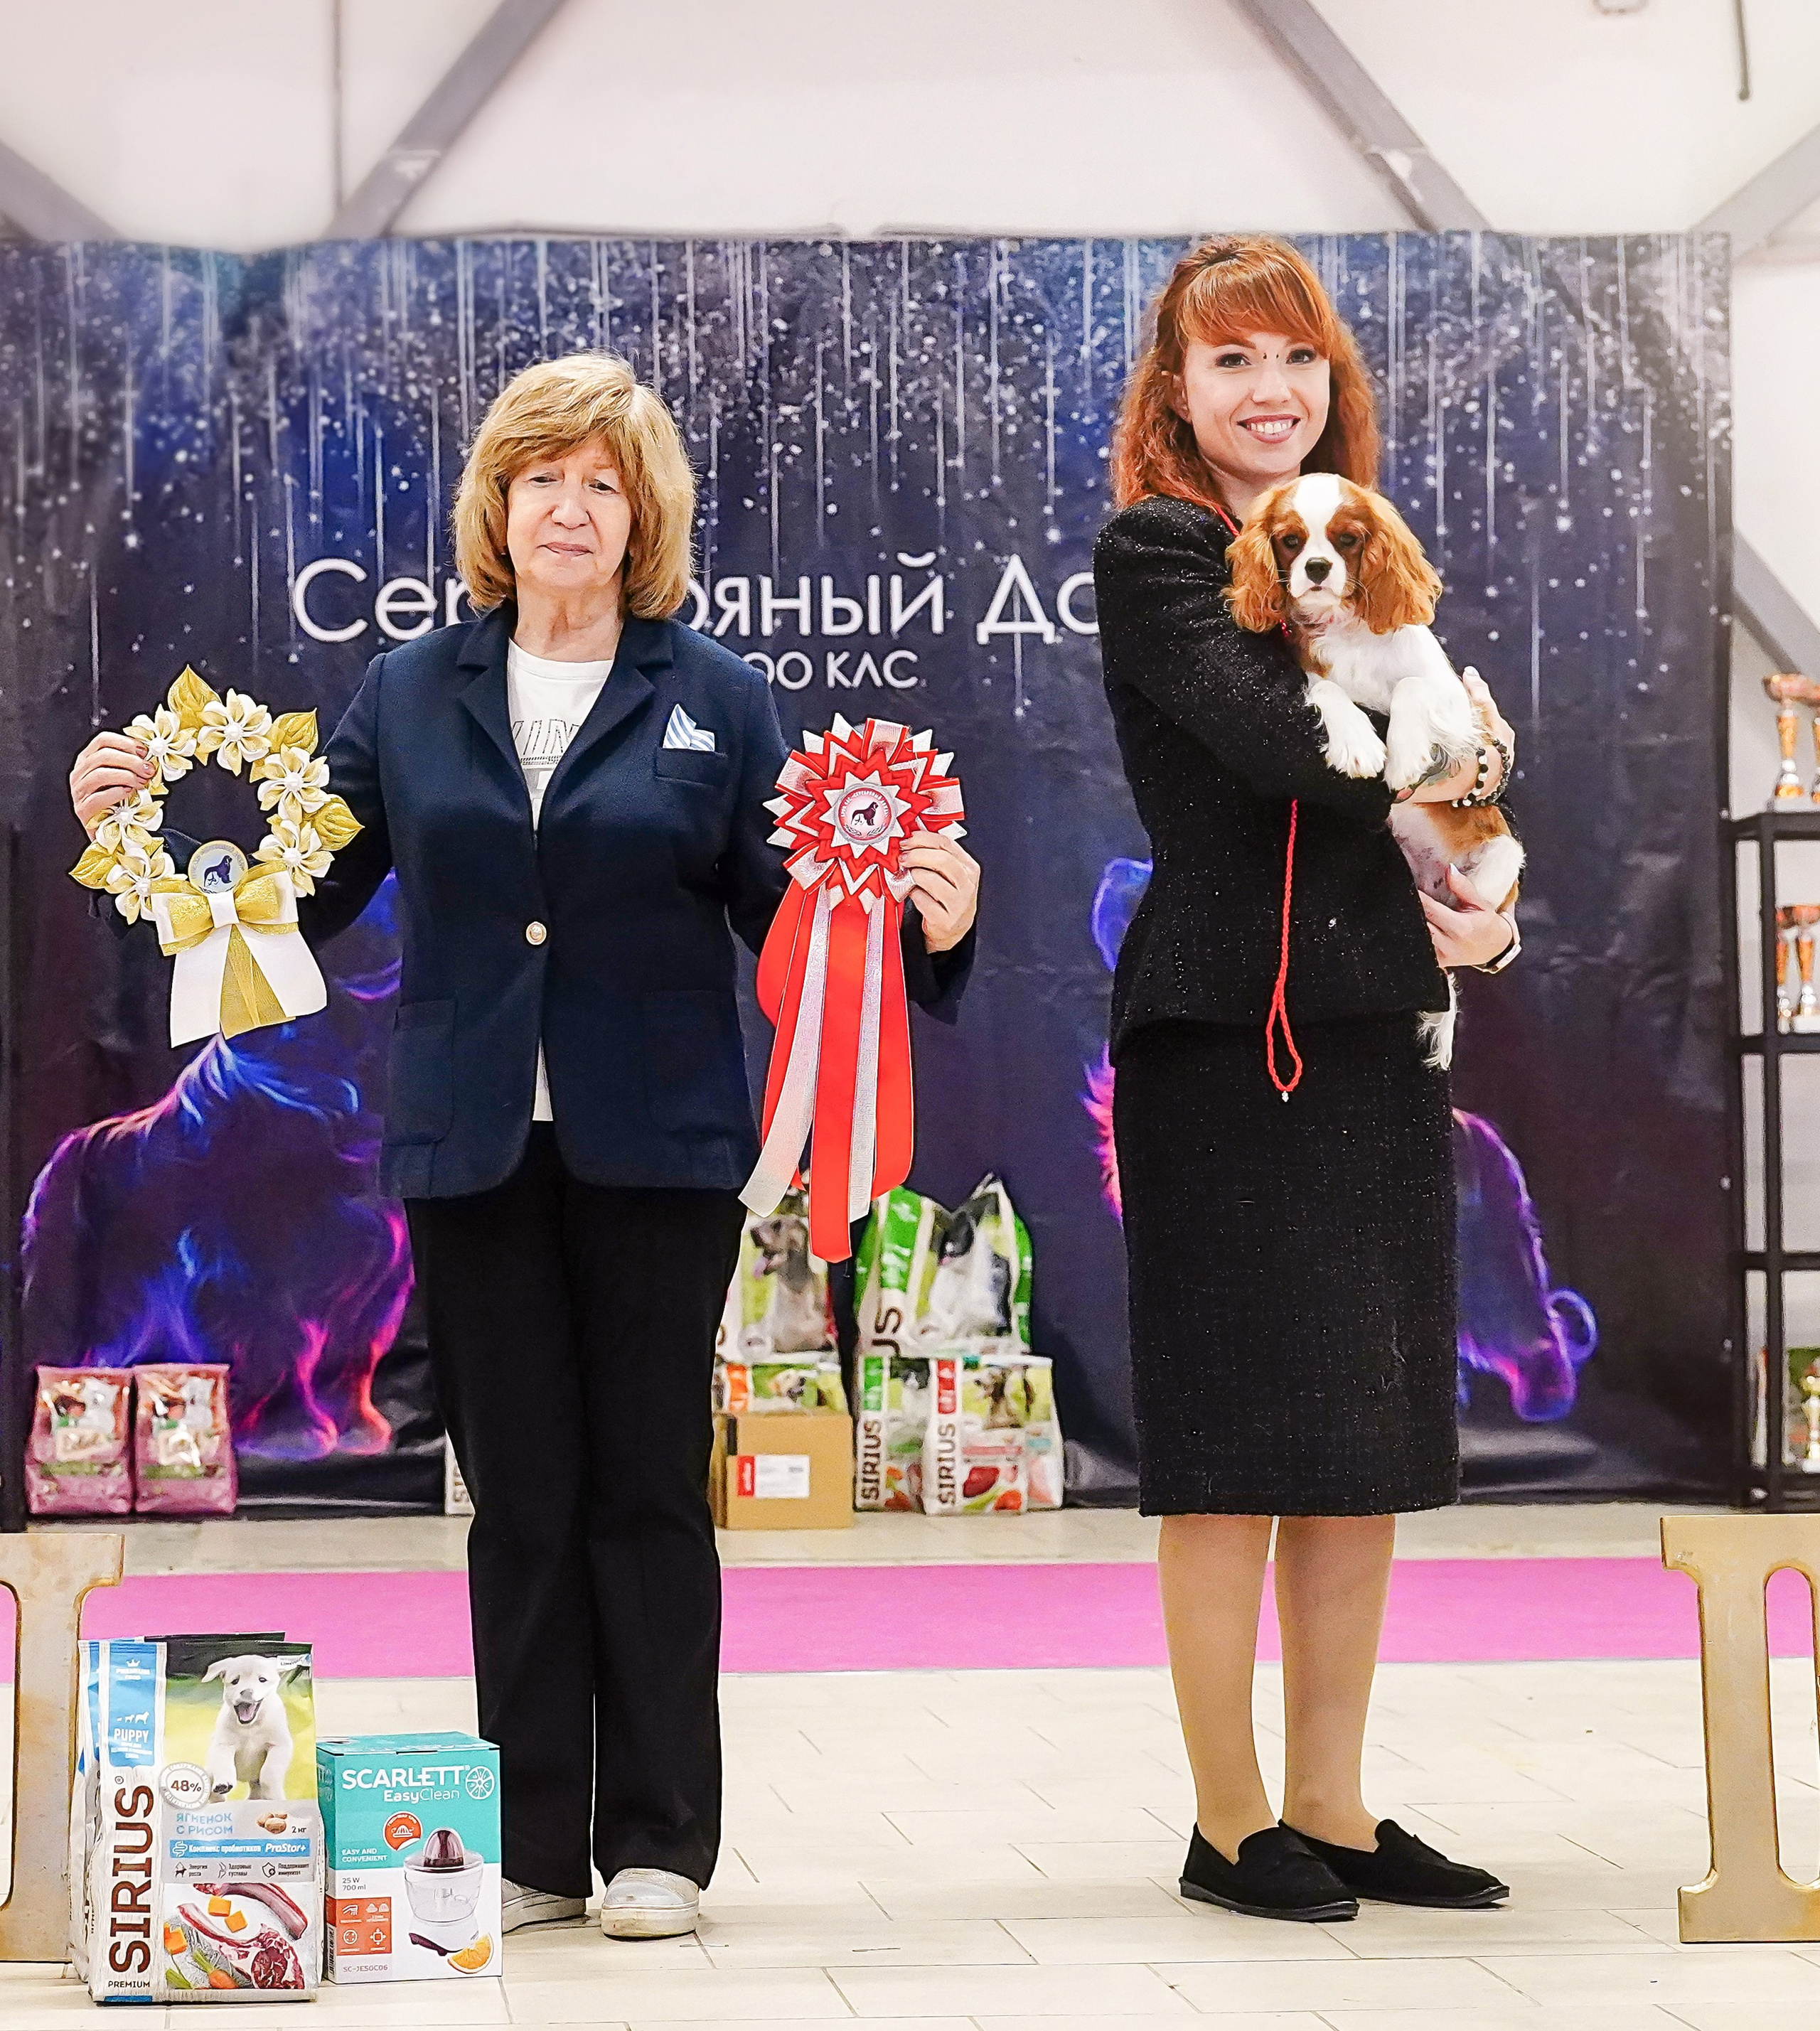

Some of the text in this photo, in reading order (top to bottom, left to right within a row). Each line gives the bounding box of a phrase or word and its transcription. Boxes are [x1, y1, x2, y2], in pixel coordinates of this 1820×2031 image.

[861, 1419, 882, 1500] SIRIUS
[937, 1422, 956, 1506] SIRIUS
[114, 1727, 149, 1744] PUPPY
[171, 1780, 202, 1792] 48%
[341, 1765, 465, 1790] SCARLETT
[383, 1788, 461, 1804] EasyClean
[176, 1812, 232, 1824] ЯГНЕНОК
[176, 1825, 234, 1836] С РИСОМ
[109, 1785, 154, 1973] SIRIUS
